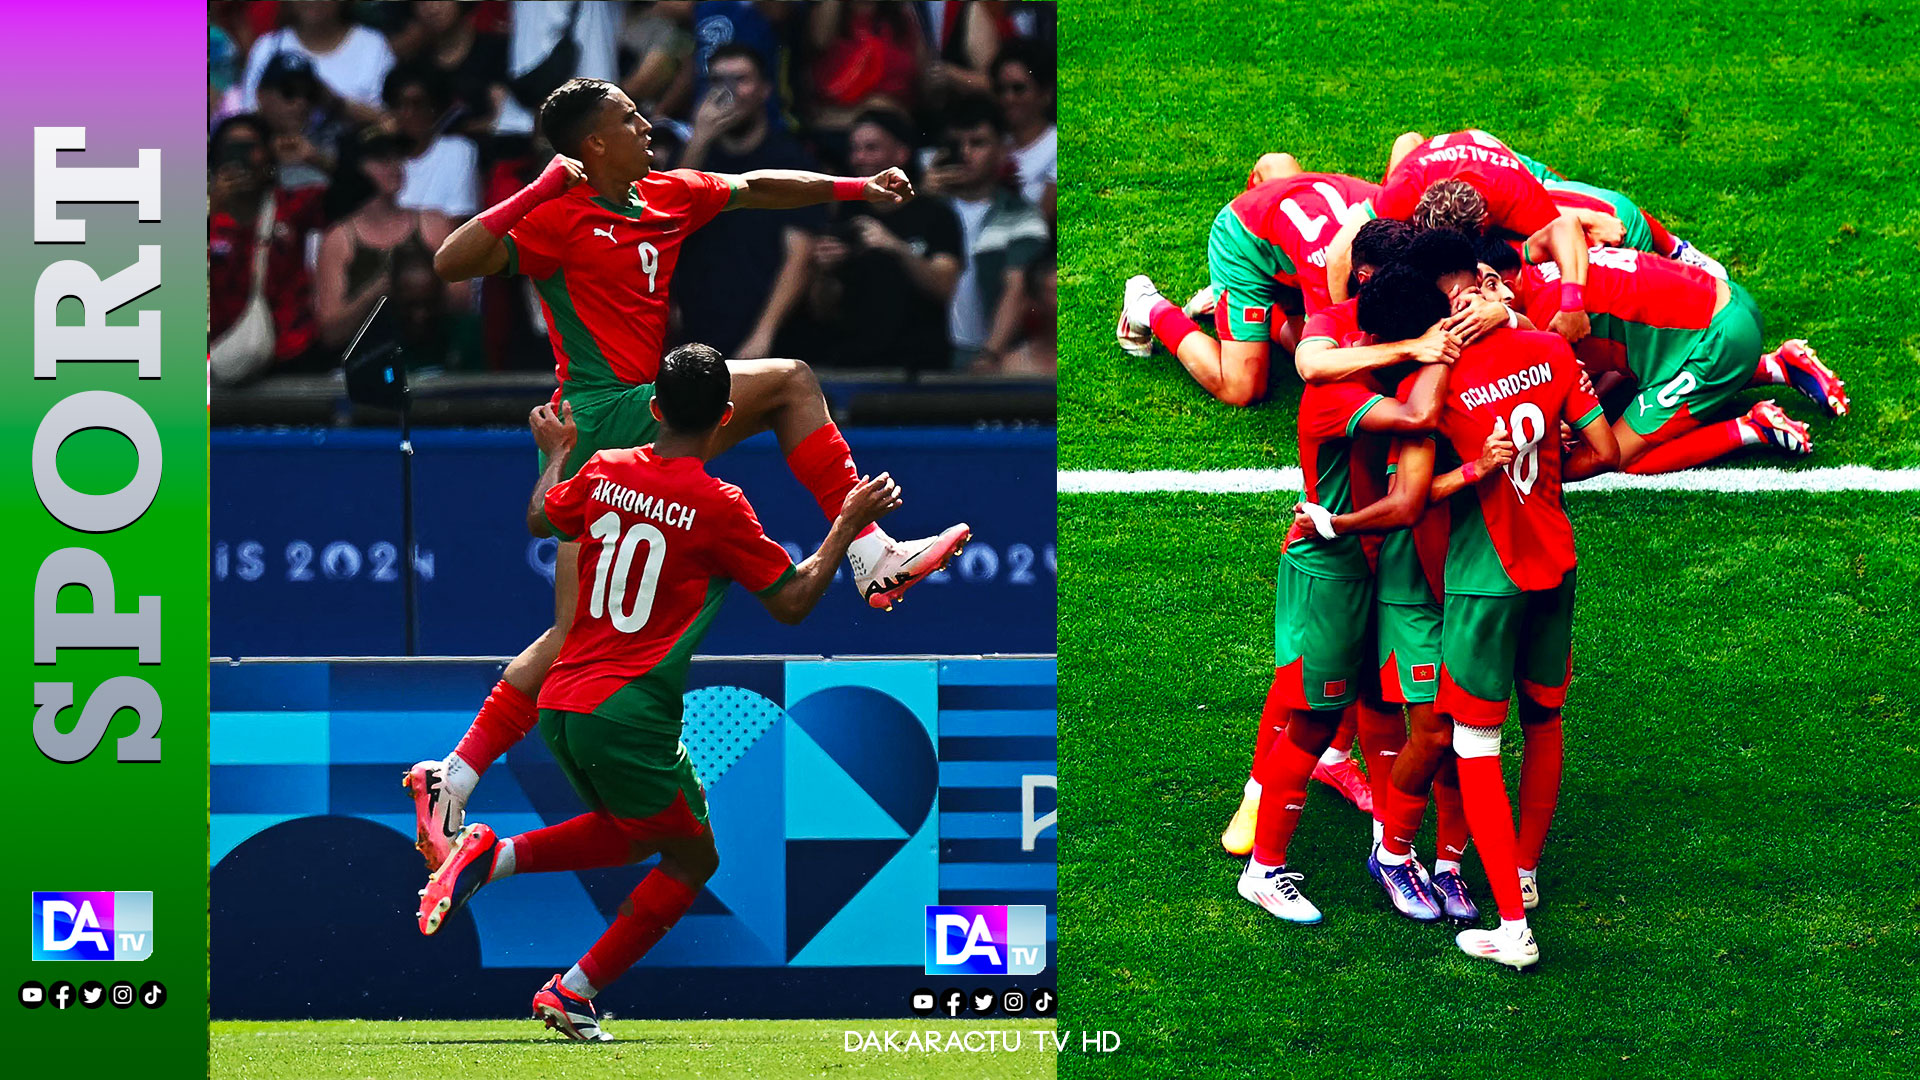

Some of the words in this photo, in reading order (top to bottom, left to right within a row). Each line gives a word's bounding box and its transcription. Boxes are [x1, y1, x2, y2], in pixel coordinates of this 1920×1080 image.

[637, 241, 659, 293] 9
[1459, 362, 1553, 411] RCHARDSON
[591, 479, 697, 531] AKHOMACH
[284, 540, 436, 582] 2024
[589, 511, 667, 633] 10
